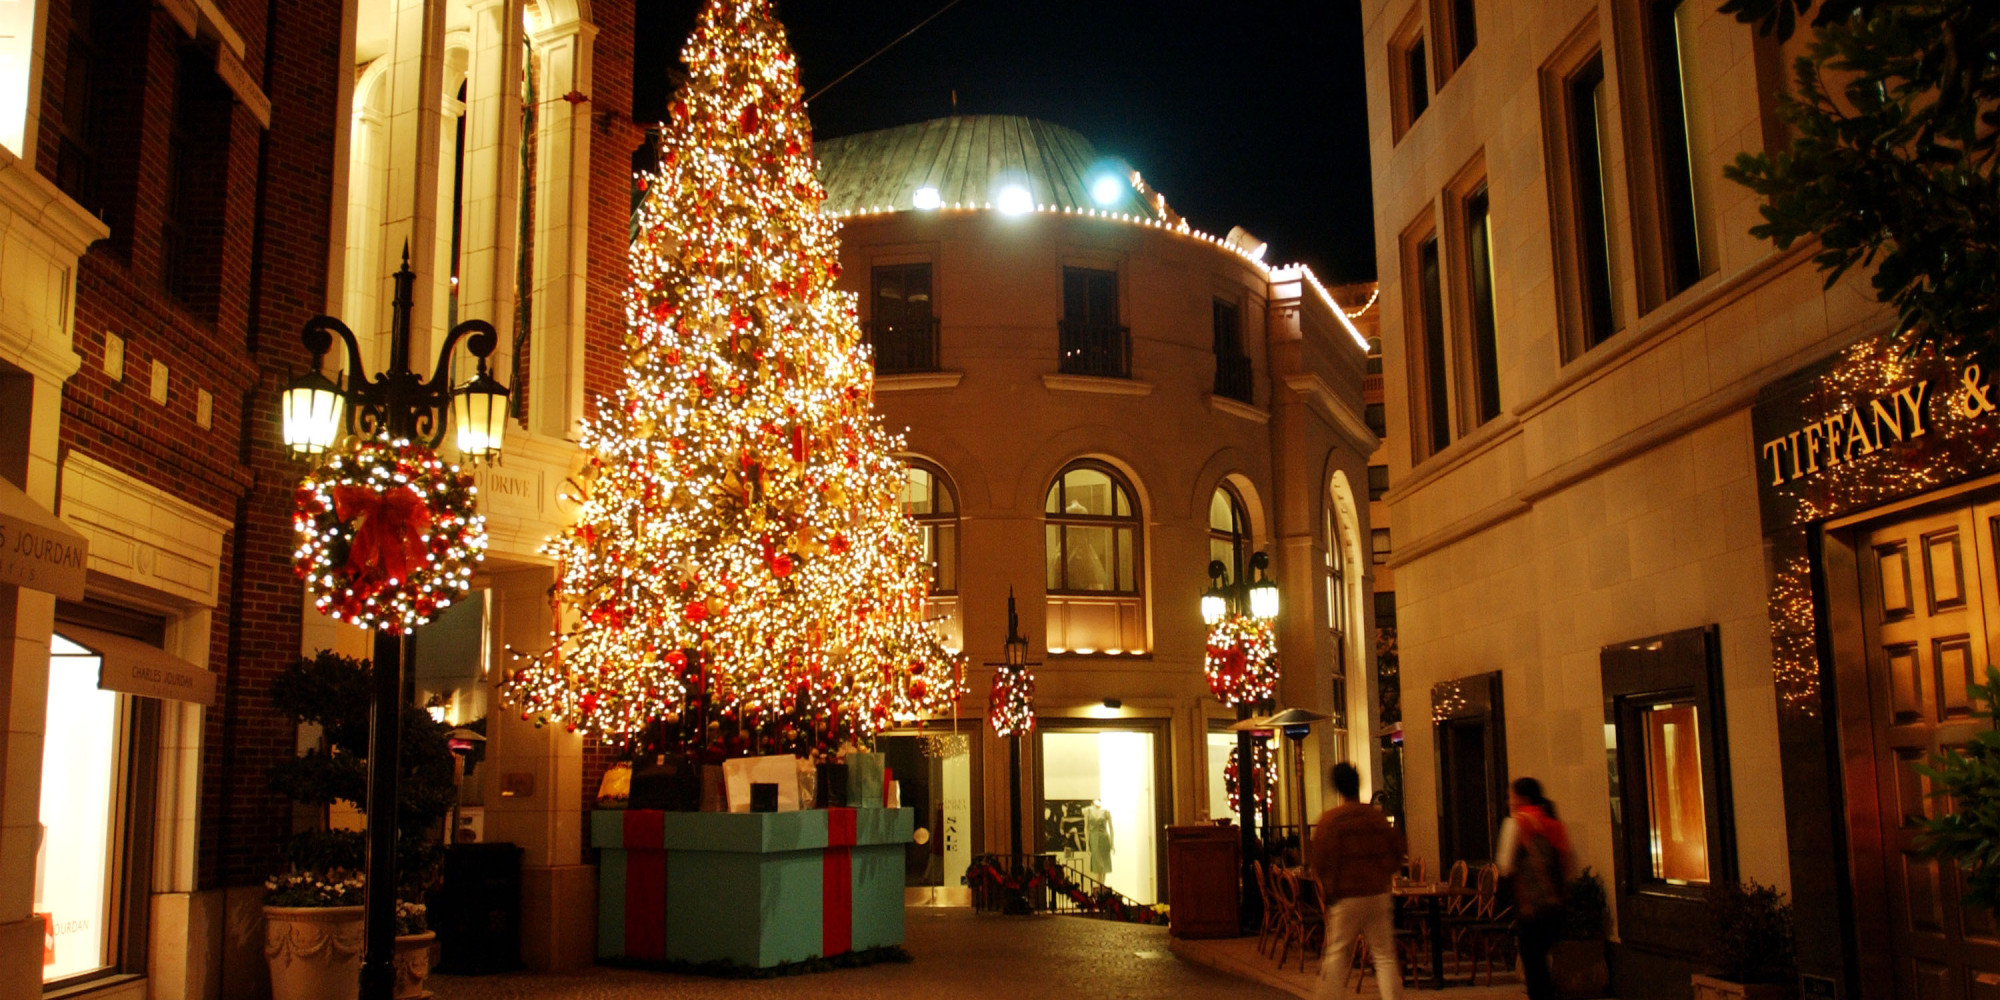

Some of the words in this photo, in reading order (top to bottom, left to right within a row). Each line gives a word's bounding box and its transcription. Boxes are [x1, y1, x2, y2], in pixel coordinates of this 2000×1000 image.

[1763, 380, 1927, 486] TIFFANY
[1962, 364, 1996, 419] &
[490, 473, 531, 498] DRIVE
[14, 531, 83, 568] JOURDAN
[132, 666, 162, 682] CHARLES
[164, 672, 193, 688] JOURDAN
[946, 816, 958, 852] SALE
